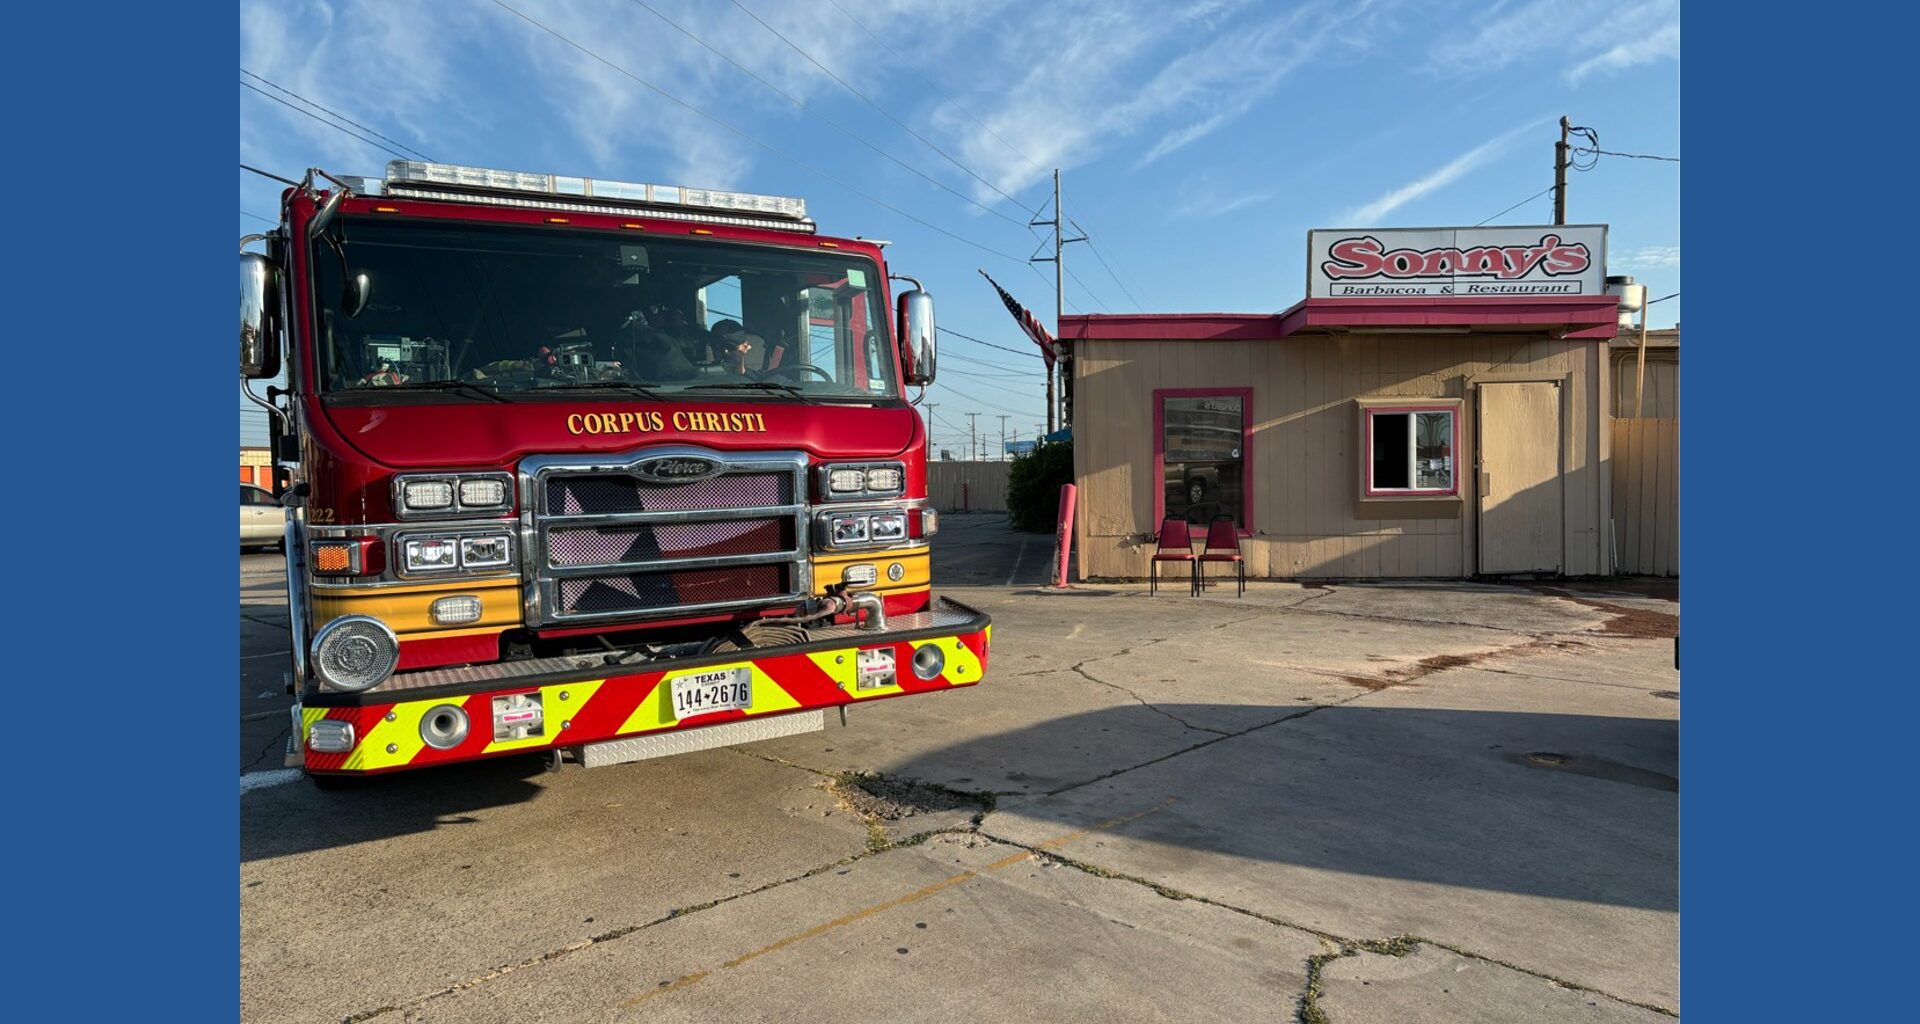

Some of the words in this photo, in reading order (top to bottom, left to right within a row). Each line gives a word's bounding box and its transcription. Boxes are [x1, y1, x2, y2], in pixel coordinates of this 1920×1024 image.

[1321, 234, 1590, 280] Sonny's
[1341, 285, 1426, 295] Barbacoa
[1440, 285, 1454, 294] &
[1467, 284, 1571, 294] Restaurant
[567, 411, 665, 435] CORPUS
[672, 411, 767, 432] CHRISTI
[652, 459, 706, 476] Pierce
[695, 672, 726, 683] TEXAS
